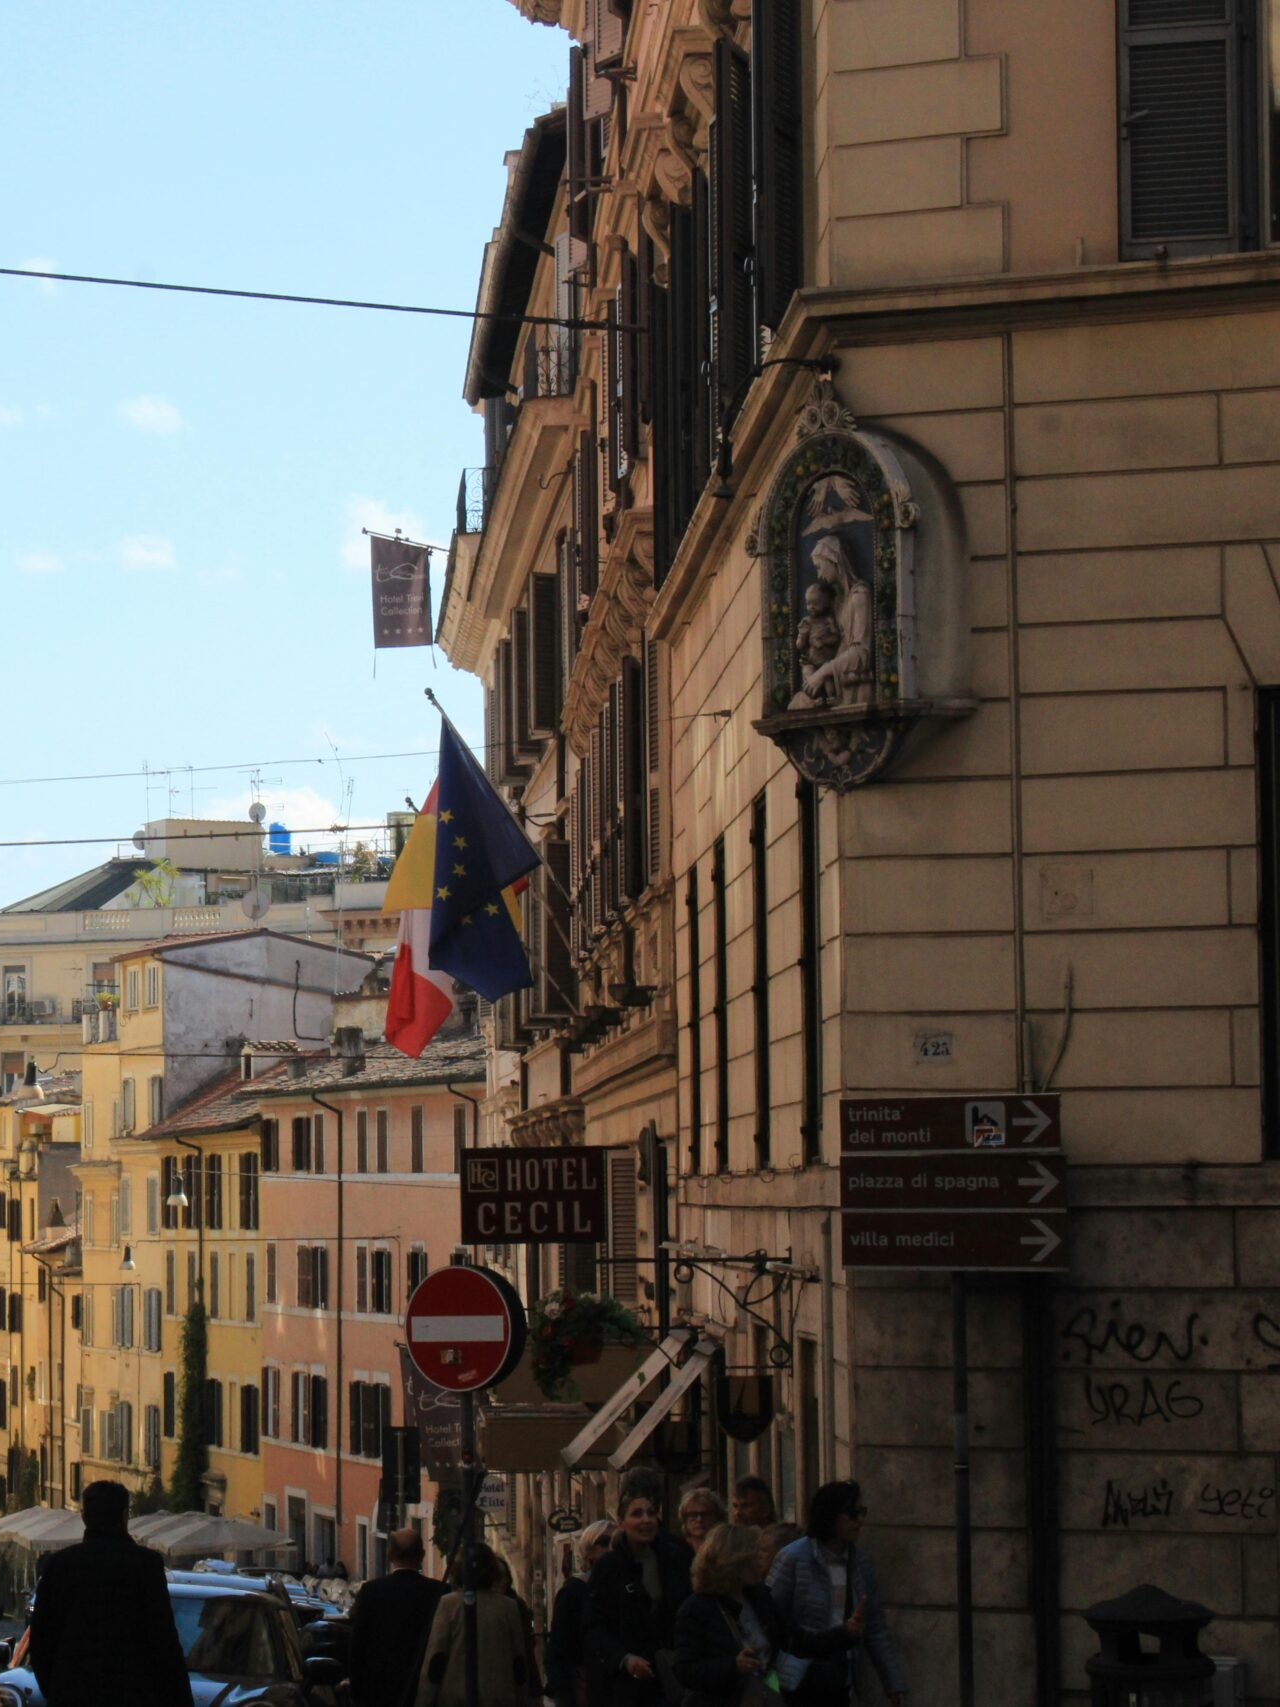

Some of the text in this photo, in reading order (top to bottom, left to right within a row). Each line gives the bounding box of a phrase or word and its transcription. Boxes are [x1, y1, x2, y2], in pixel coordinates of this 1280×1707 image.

[380, 595, 404, 604] Hotel
[381, 606, 423, 616] Collection
[849, 1127, 931, 1144] dei monti
[506, 1158, 598, 1192] HOTEL
[848, 1173, 1000, 1191] piazza di spagna
[477, 1200, 592, 1235] CECIL
[850, 1232, 955, 1247] villa medici
[425, 1424, 451, 1434] Hotel
[428, 1437, 461, 1447] Collect
[480, 1496, 504, 1507] Elite
